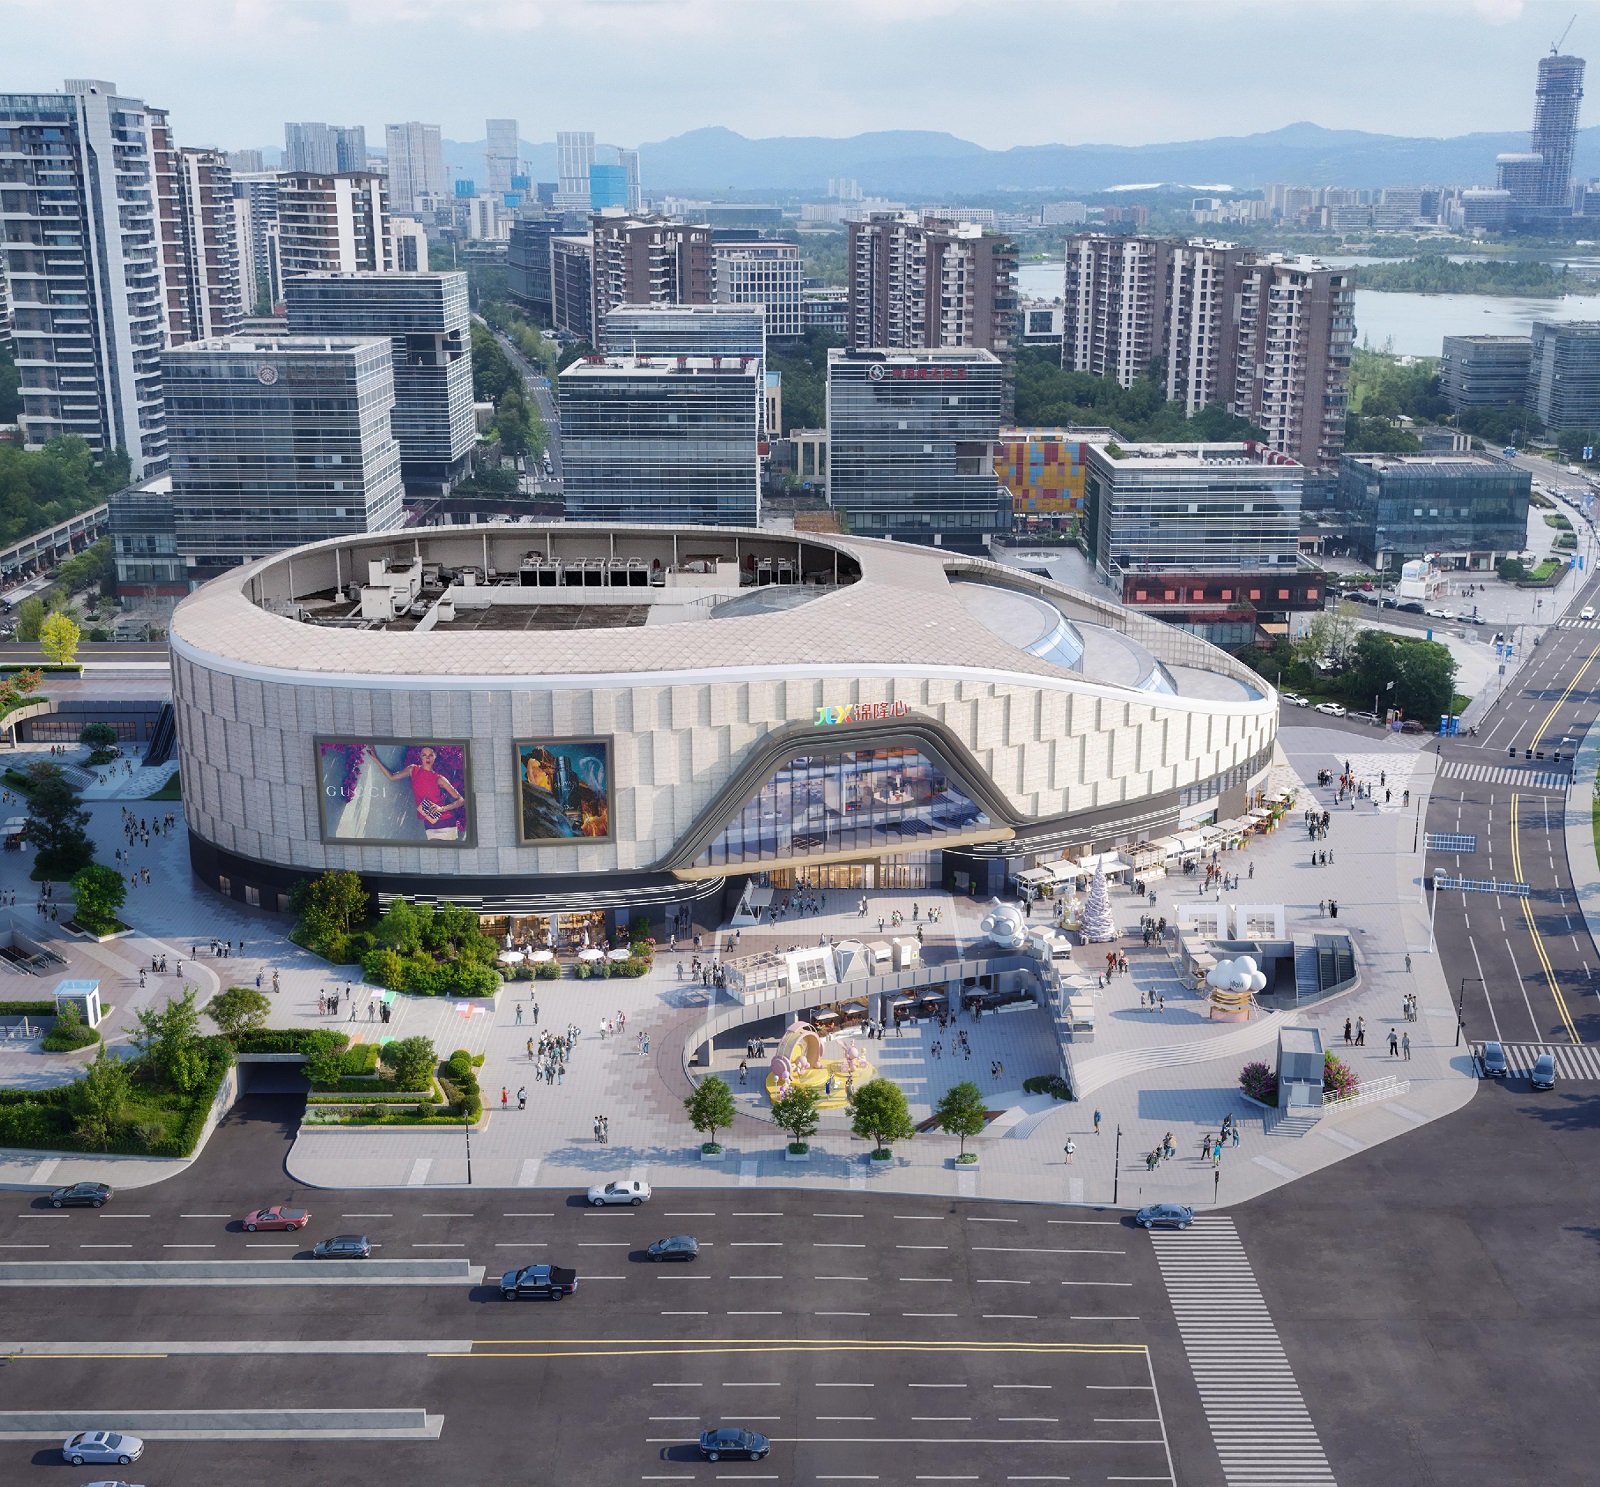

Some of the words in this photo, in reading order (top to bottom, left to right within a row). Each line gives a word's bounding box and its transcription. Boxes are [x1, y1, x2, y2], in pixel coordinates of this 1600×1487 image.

[854, 700, 908, 721] 锦隆心
[326, 785, 386, 798] GUCCI
